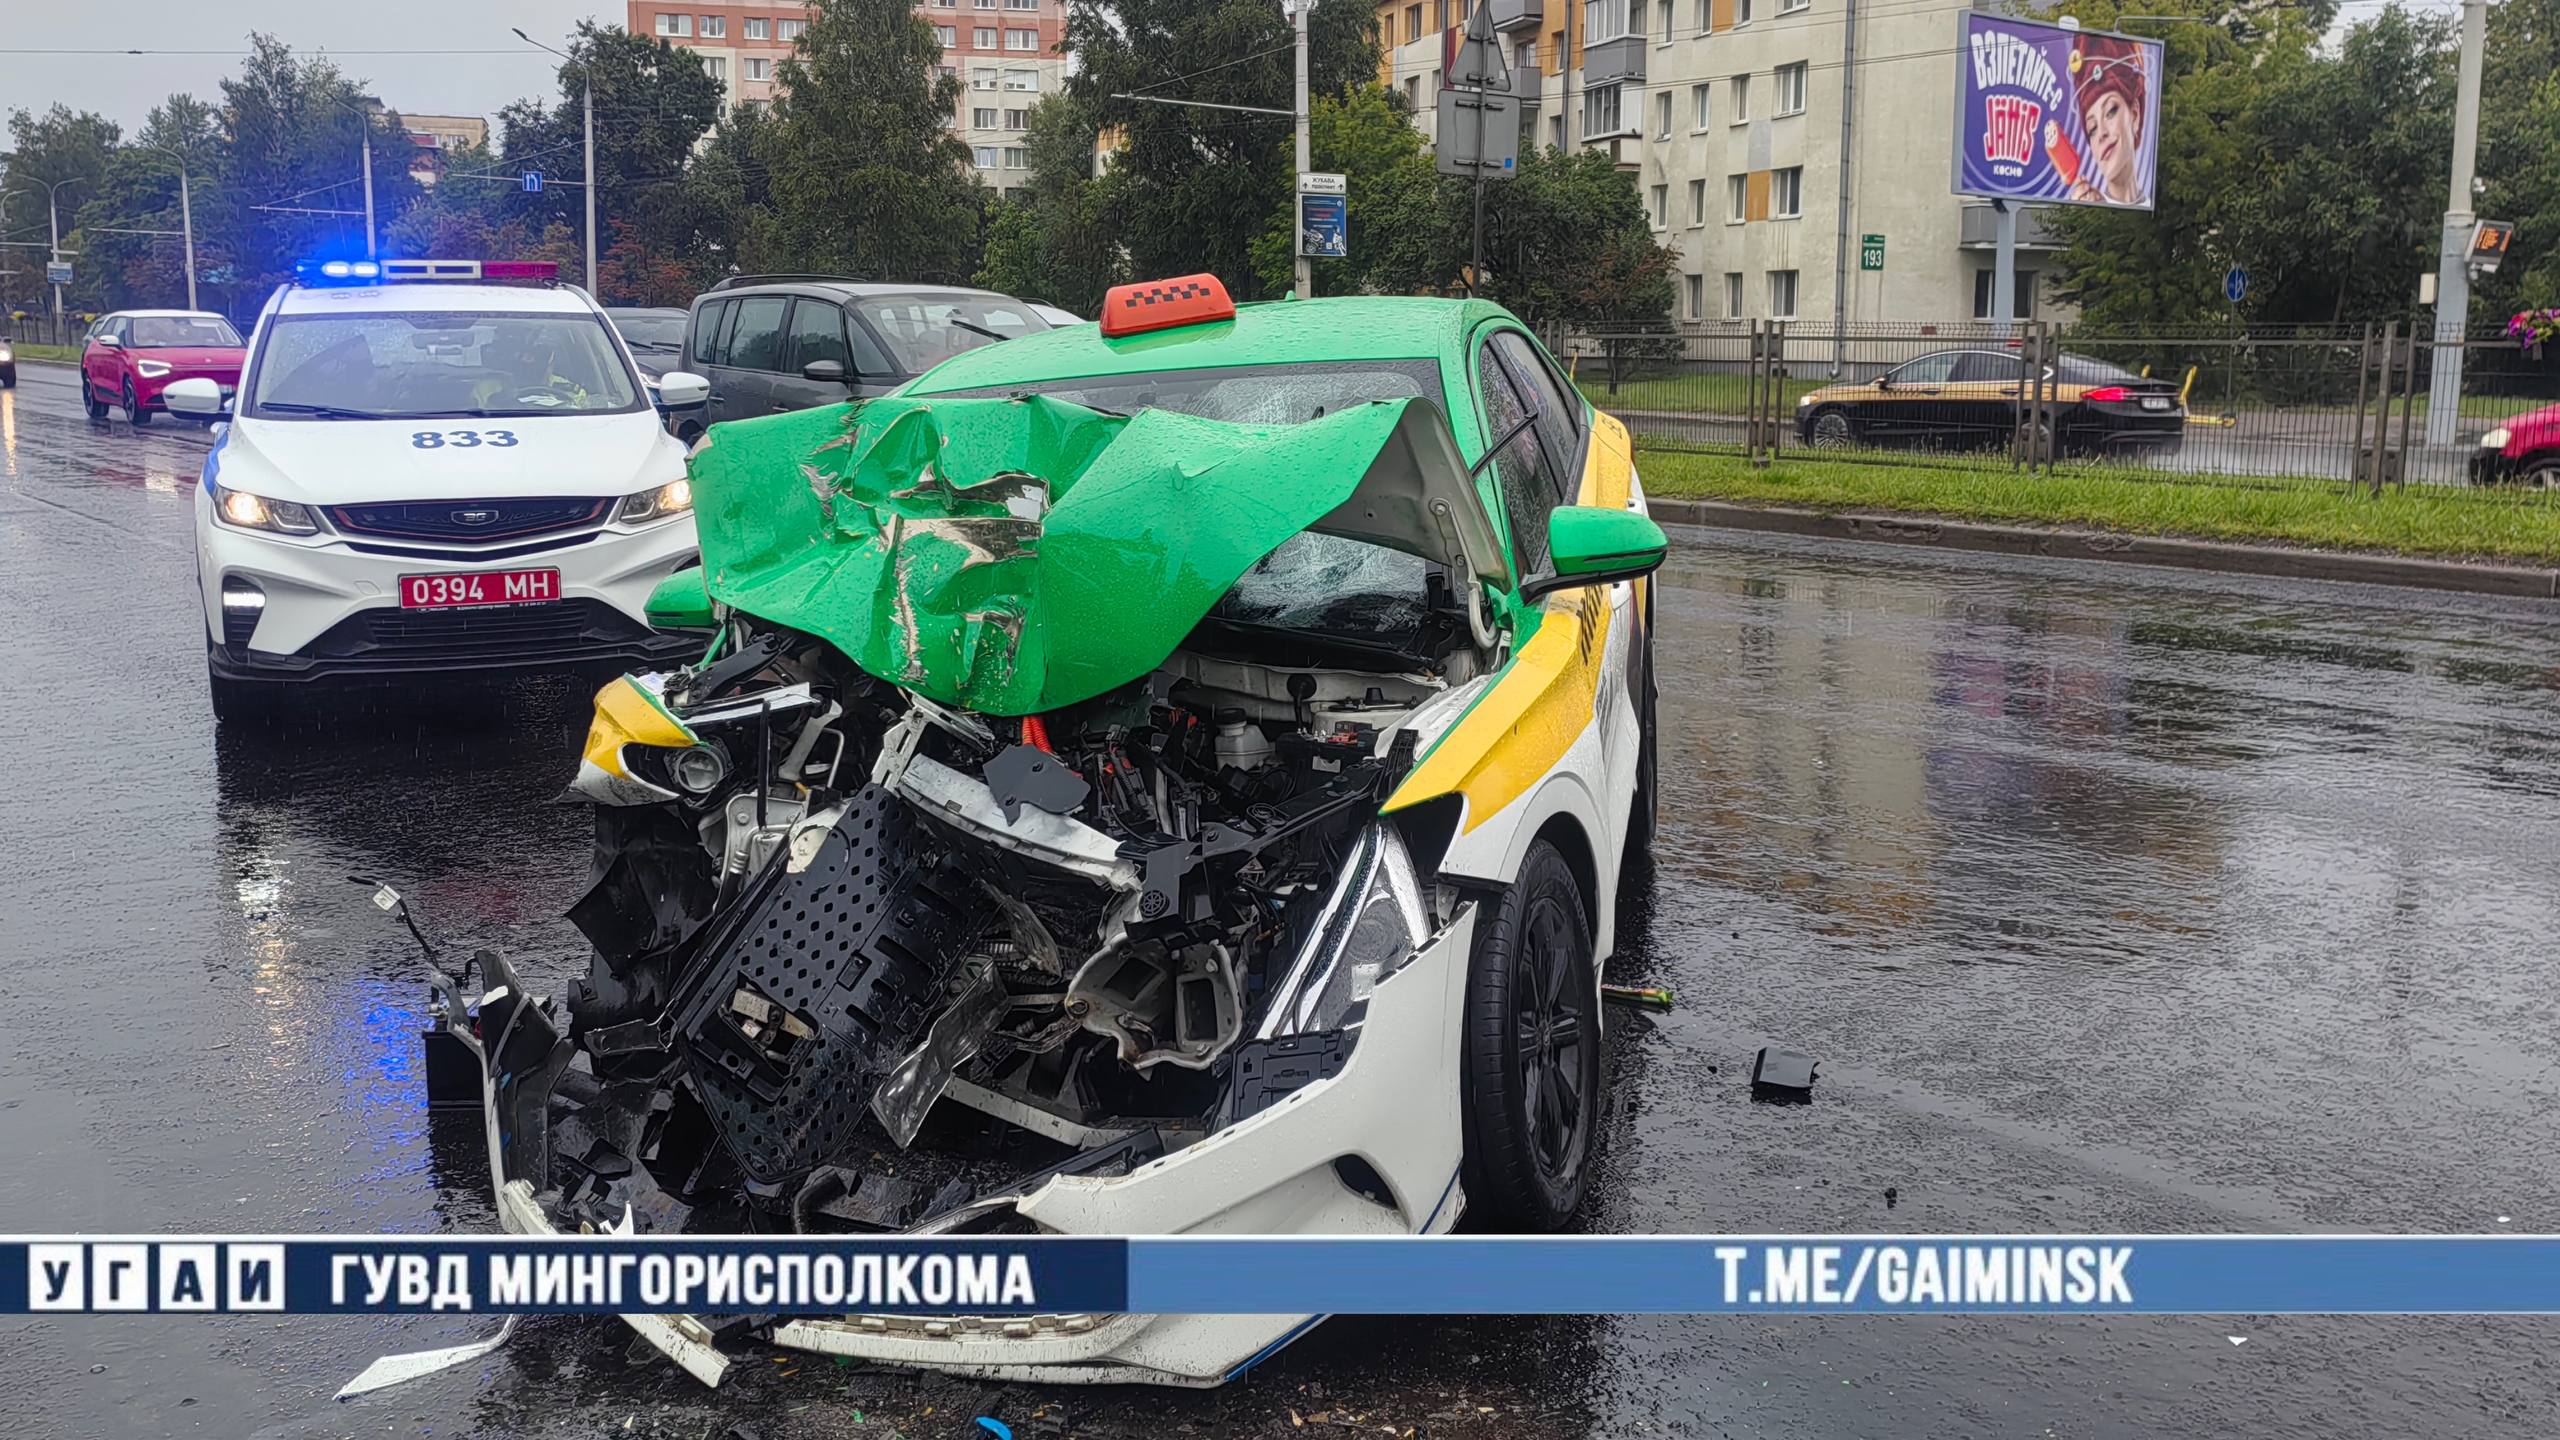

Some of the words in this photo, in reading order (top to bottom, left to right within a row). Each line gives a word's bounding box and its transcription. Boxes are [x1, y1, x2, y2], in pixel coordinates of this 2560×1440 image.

[1863, 249, 1882, 267] 193
[411, 430, 519, 449] 833
[412, 576, 484, 604] 0394
